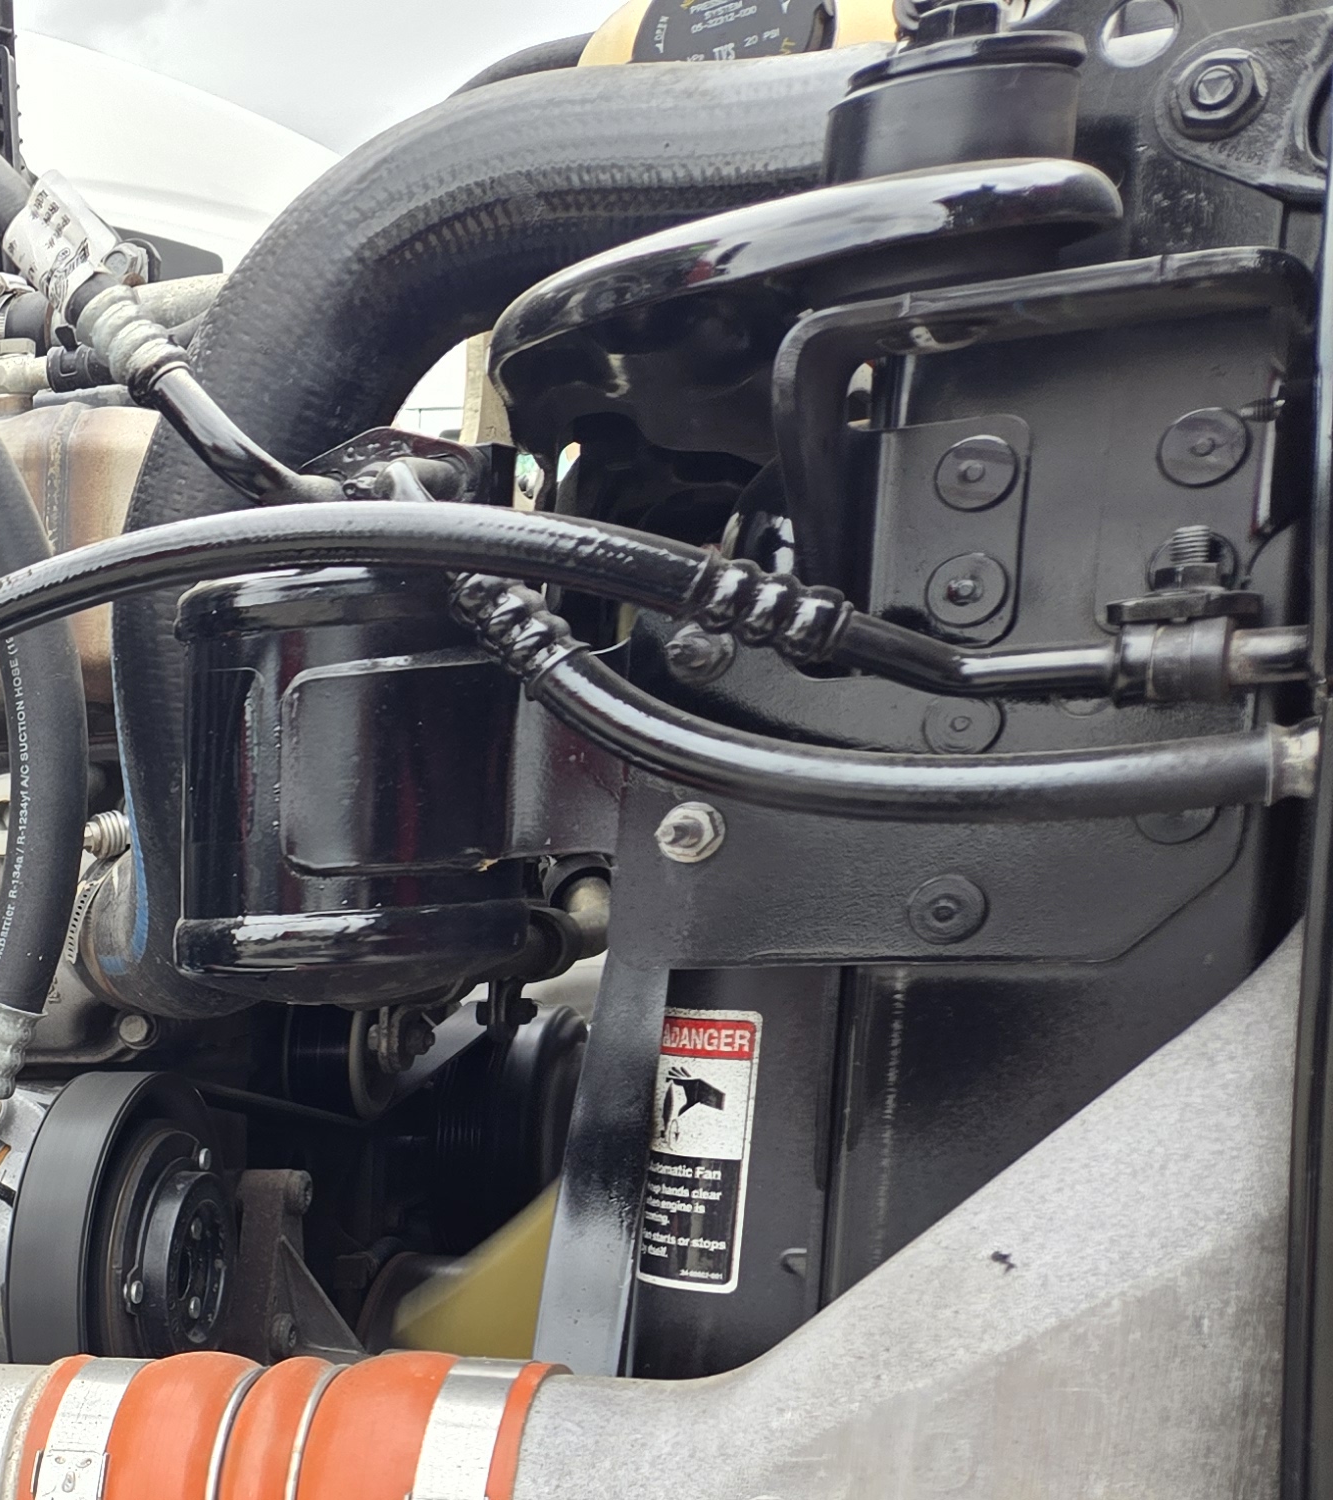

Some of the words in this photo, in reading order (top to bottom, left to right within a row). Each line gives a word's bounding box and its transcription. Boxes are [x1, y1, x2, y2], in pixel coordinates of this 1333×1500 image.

[762, 27, 781, 42] PSI
[8, 657, 23, 698] HOSE
[15, 700, 29, 762] SUCTION
[18, 764, 30, 788] A/C
[16, 789, 32, 846] R-1234yf
[8, 855, 25, 899] R-134a
[671, 1026, 751, 1052] DANGER
[694, 1166, 722, 1181] Fan
[661, 1183, 690, 1198] hands
[691, 1188, 723, 1201] clear
[661, 1200, 693, 1214] engine
[694, 1202, 706, 1214] is
[677, 1236, 690, 1247] or
[690, 1237, 727, 1252] stops
